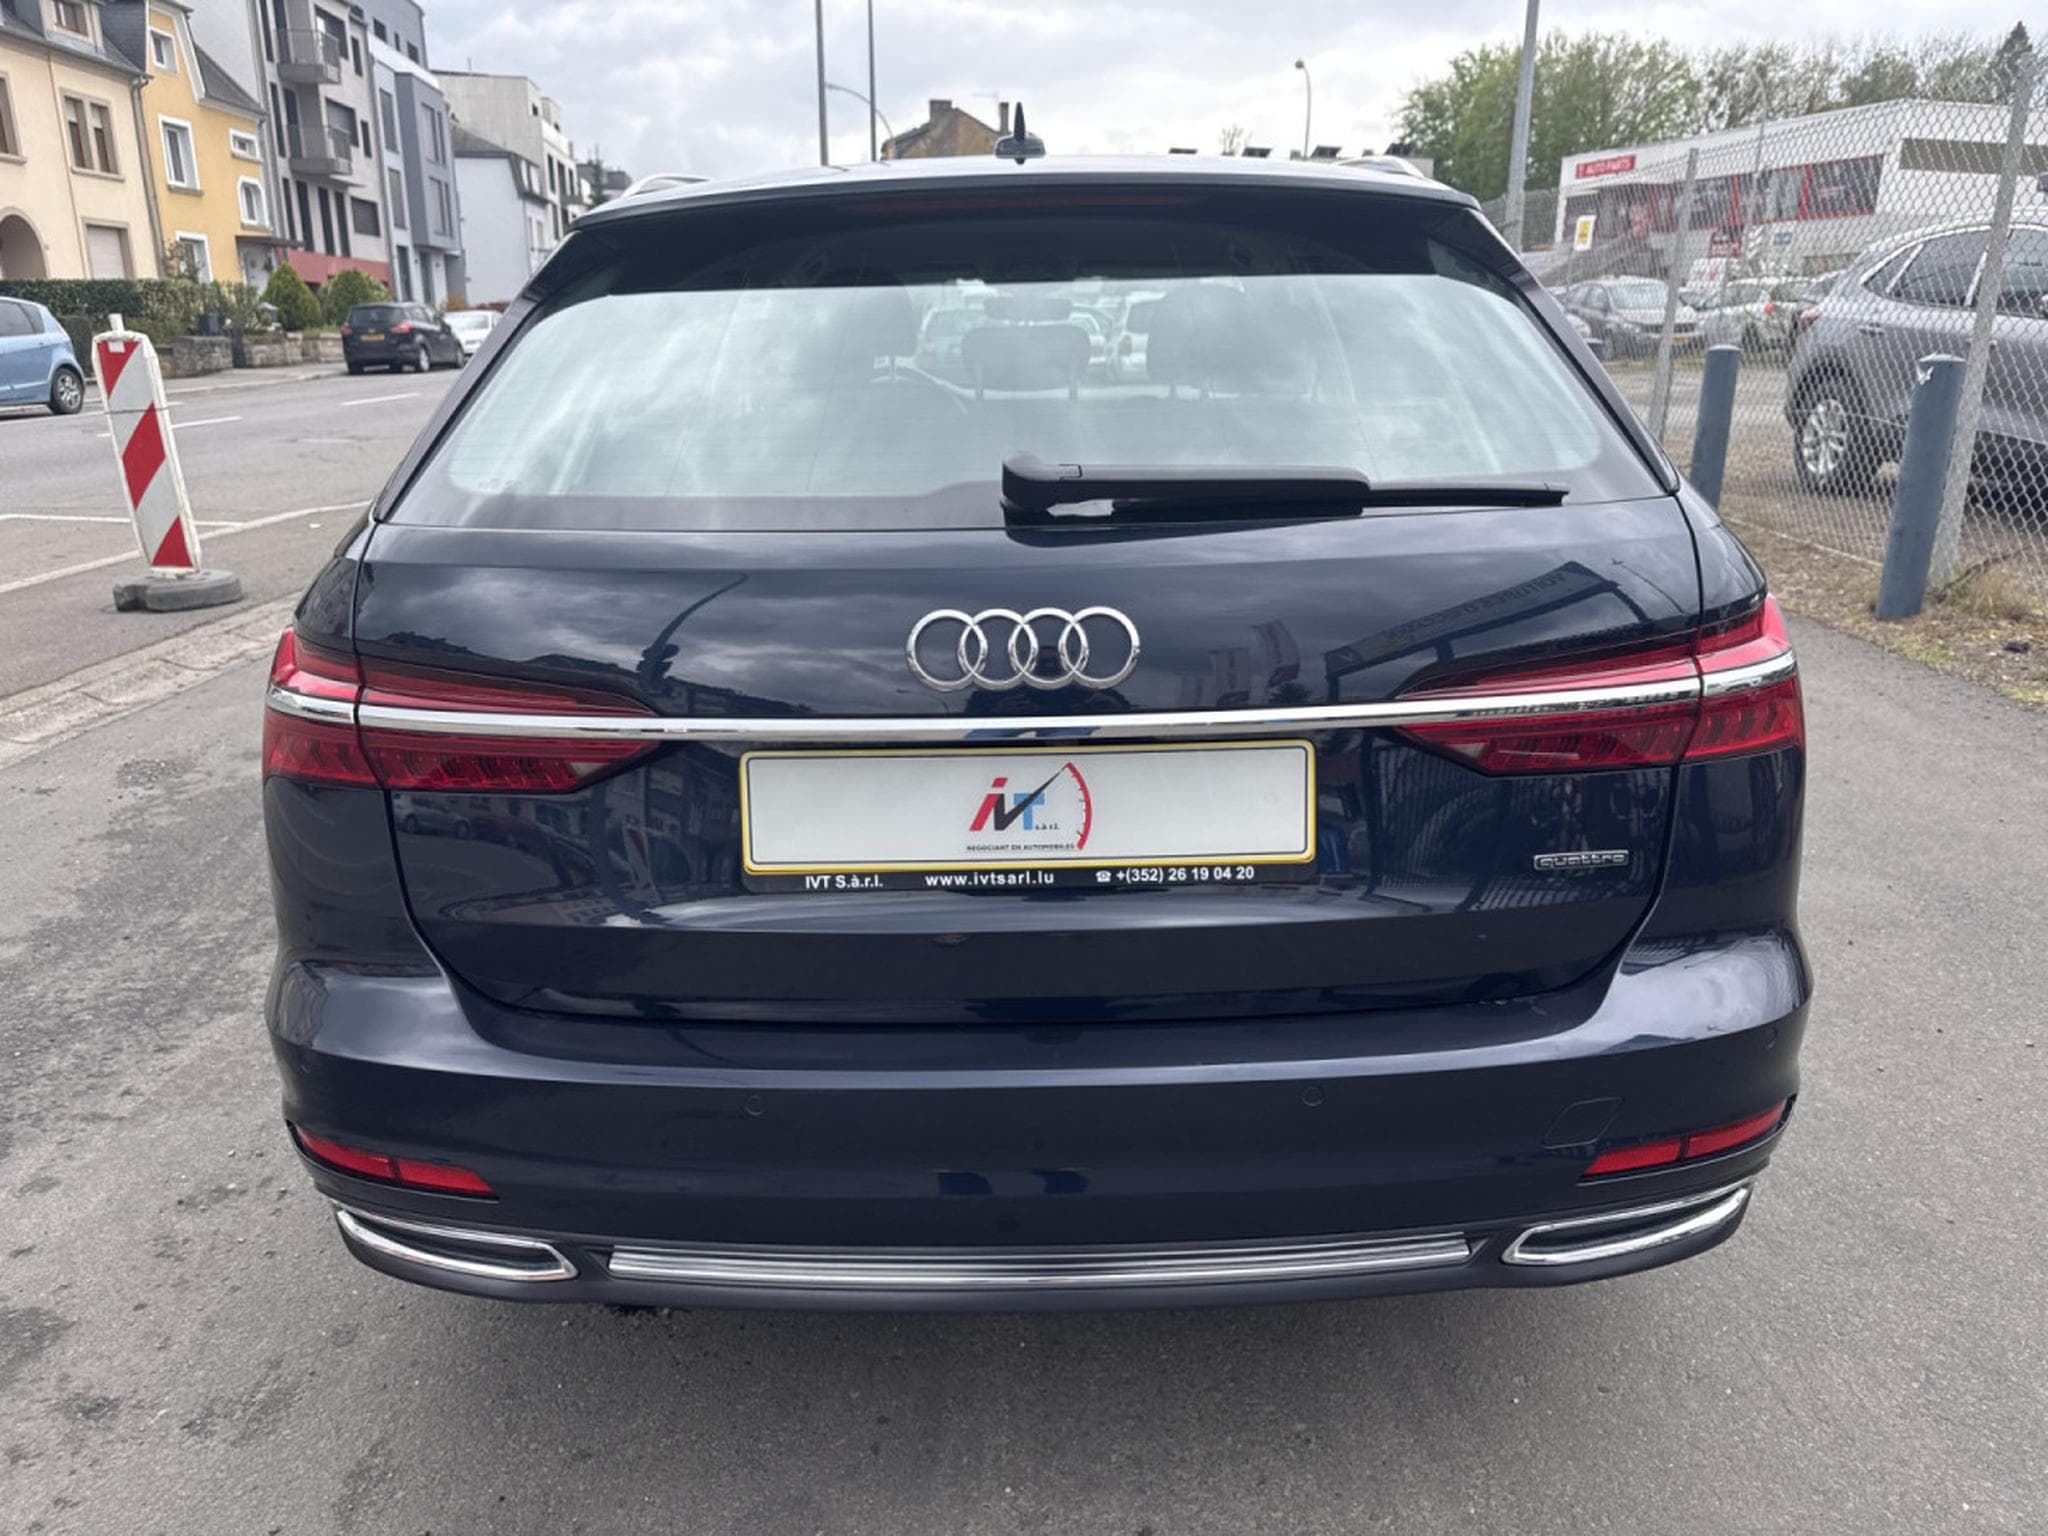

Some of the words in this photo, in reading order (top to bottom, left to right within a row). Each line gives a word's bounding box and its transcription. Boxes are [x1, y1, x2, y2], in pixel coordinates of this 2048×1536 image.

[1540, 854, 1625, 868] quattro
[805, 876, 830, 889] IVT
[924, 871, 1055, 887] www.ivtsarl.lu
[1116, 867, 1164, 884] +(352)
[1168, 868, 1187, 881] 26
[1191, 867, 1209, 880] 19
[1213, 866, 1232, 880] 04
[1236, 866, 1255, 879] 20
